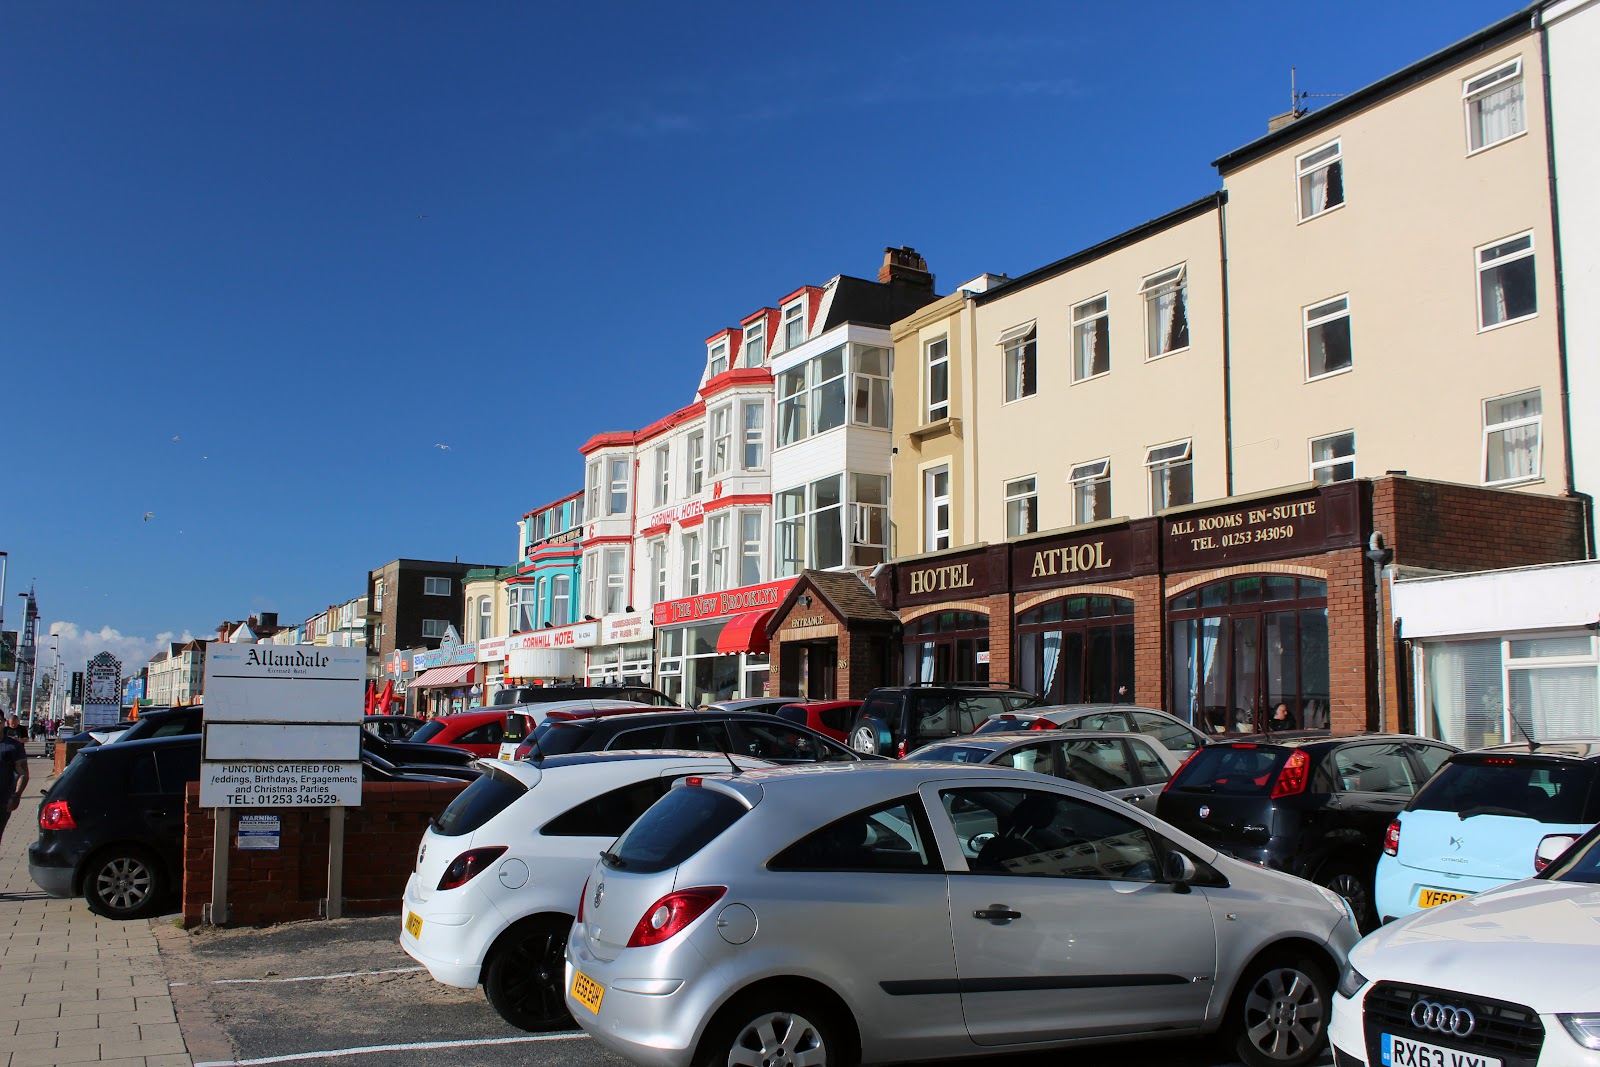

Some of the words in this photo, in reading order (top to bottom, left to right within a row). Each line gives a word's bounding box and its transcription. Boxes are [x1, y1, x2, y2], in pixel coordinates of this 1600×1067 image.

[681, 500, 703, 518] HOTEL
[1171, 519, 1195, 536] ALL
[1198, 512, 1243, 532] ROOMS
[1248, 500, 1317, 524] EN-SUITE
[1191, 535, 1218, 552] TEL.
[1221, 529, 1252, 547] 01253
[1254, 524, 1293, 543] 343050
[909, 563, 975, 595] HOTEL
[1032, 540, 1112, 578] ATHOL
[720, 586, 779, 613] BROOKLYN
[791, 615, 825, 628] ENTRANCE
[523, 634, 551, 648] CORNHILL
[554, 630, 575, 646] HOTEL
[245, 648, 329, 668] Allandale
[222, 765, 275, 773] FUNCTIONS
[277, 765, 320, 773] CATERED
[235, 785, 252, 793] and
[254, 785, 297, 793] Christmas
[300, 785, 329, 793] Parties
[254, 776, 298, 785] Birthdays,
[226, 795, 254, 804] TEL:
[258, 795, 293, 804] 01253
[1394, 1039, 1445, 1067] RX63
